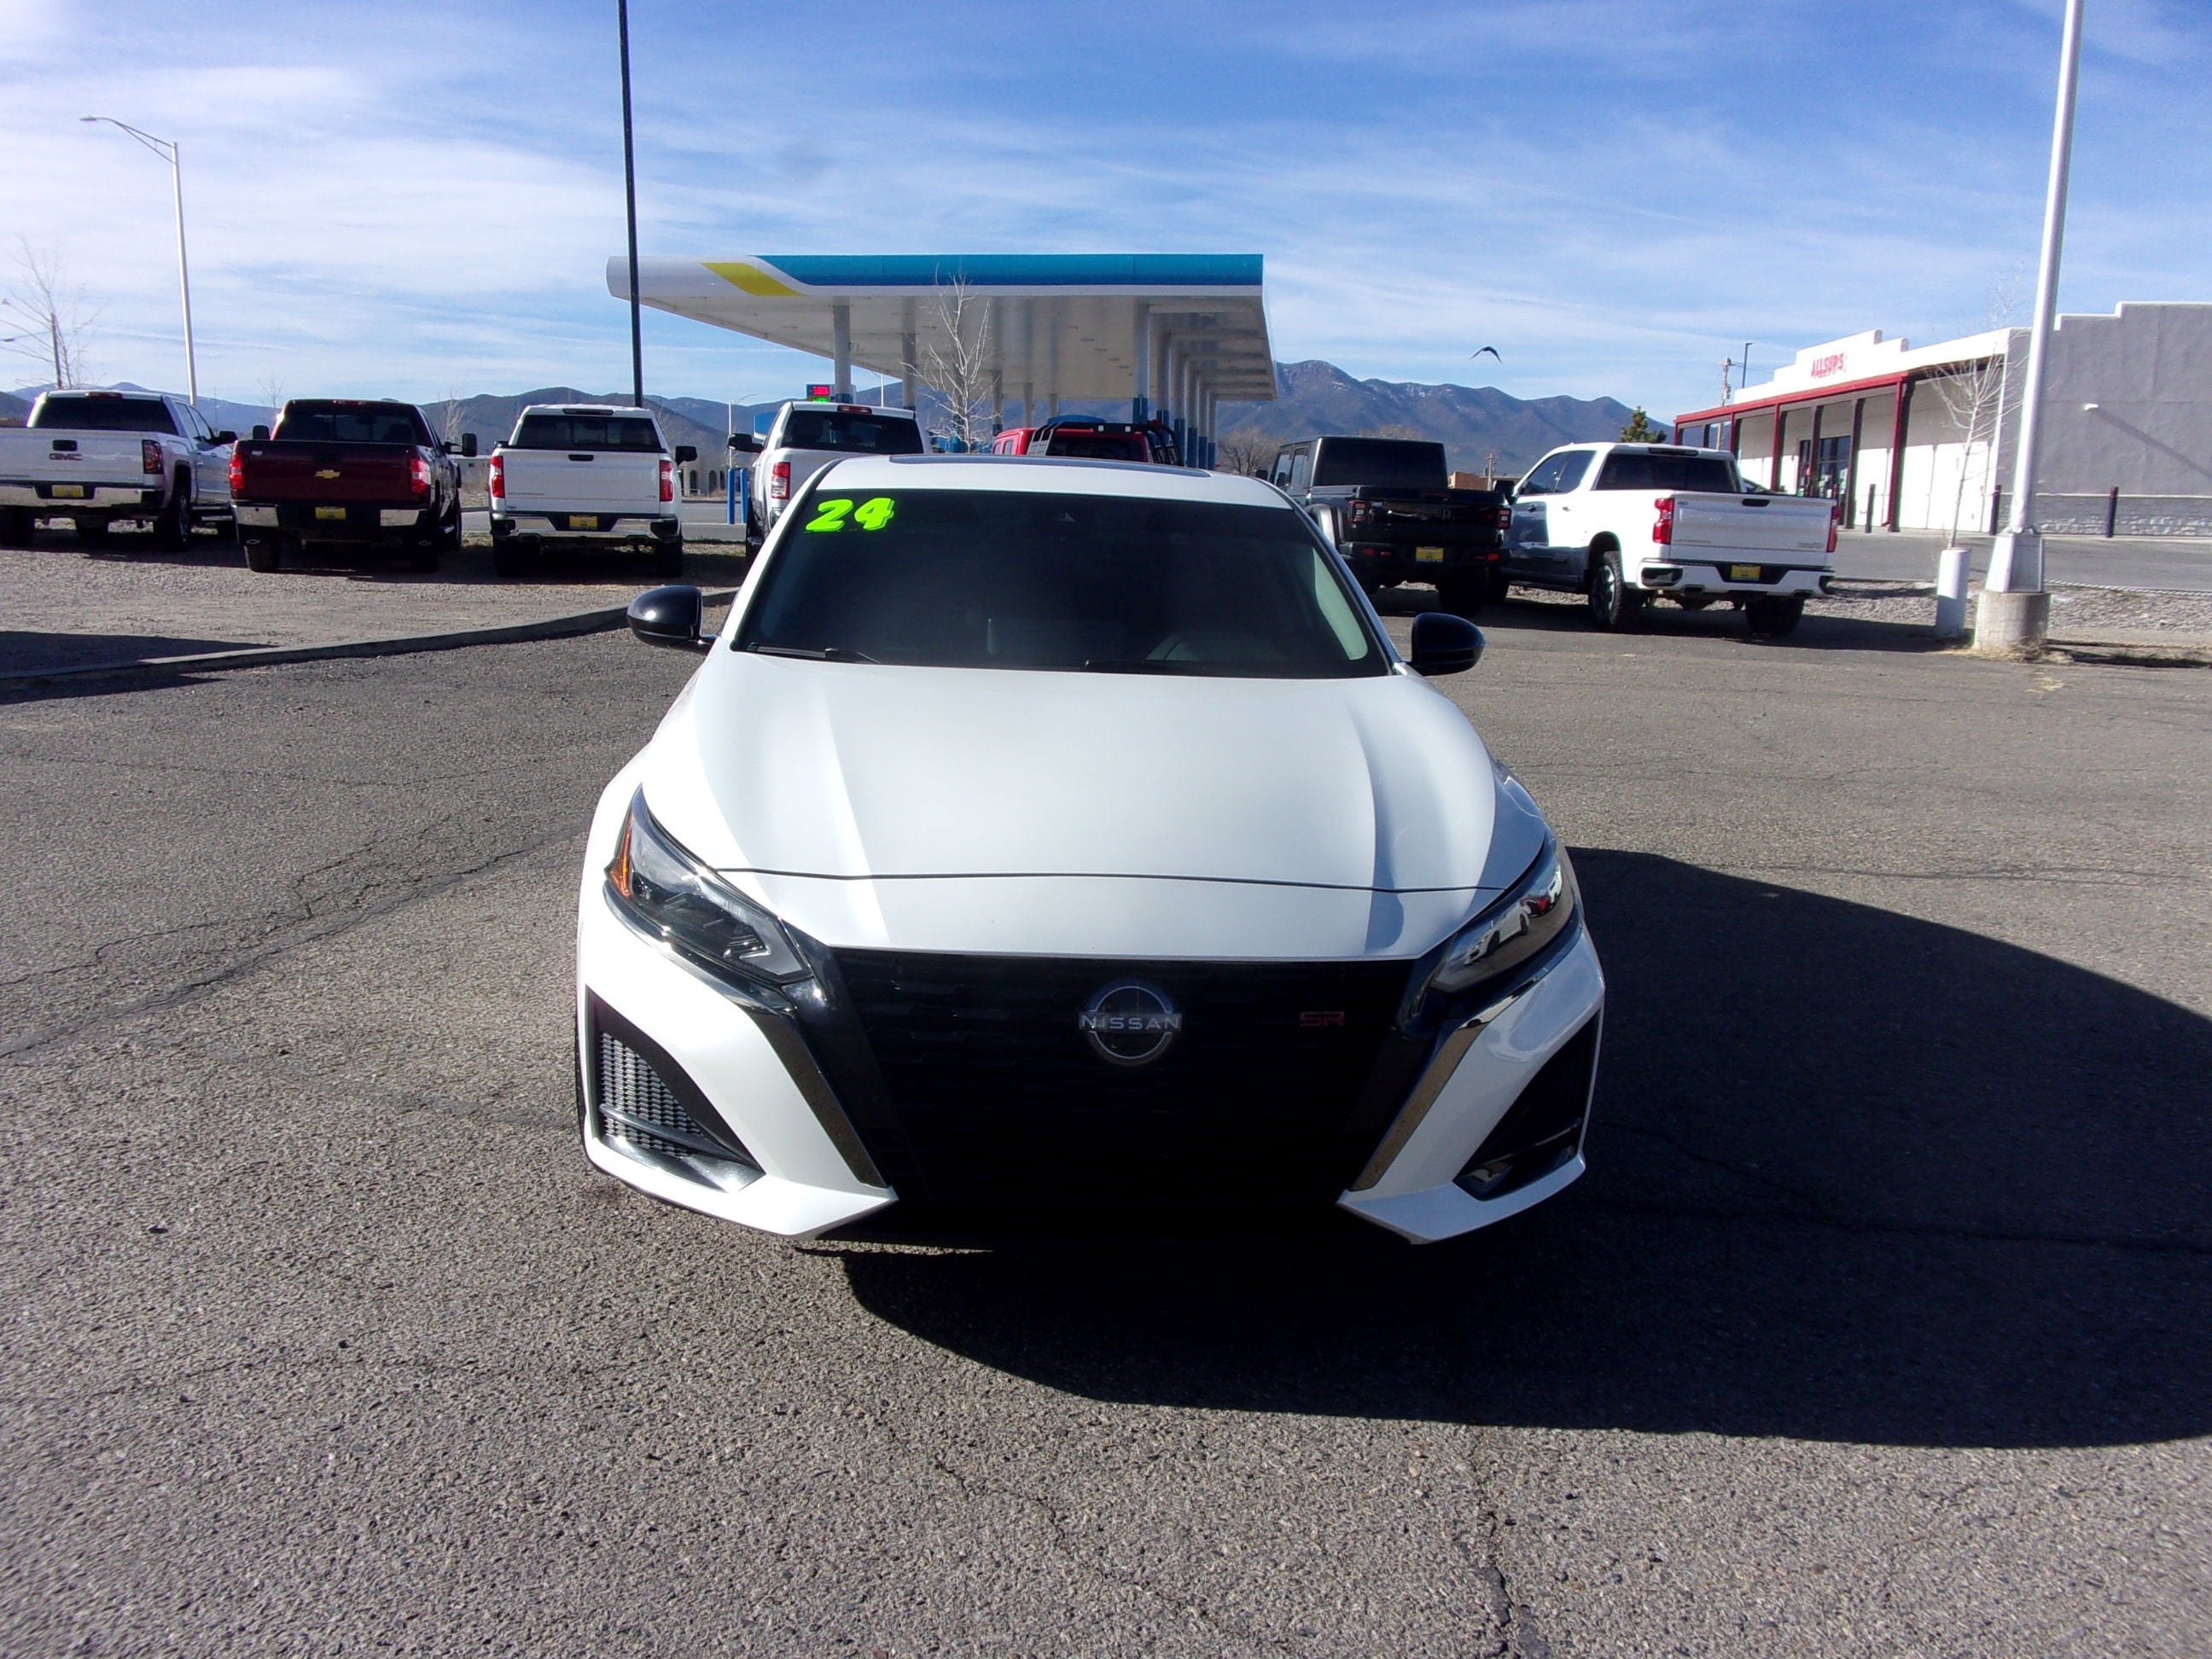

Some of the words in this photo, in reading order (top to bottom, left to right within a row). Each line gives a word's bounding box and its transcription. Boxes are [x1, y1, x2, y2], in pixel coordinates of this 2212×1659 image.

[49, 452, 83, 462] GMC
[805, 496, 894, 533] 24
[1080, 1014, 1180, 1031] NISSAN
[1299, 1010, 1346, 1027] SR
